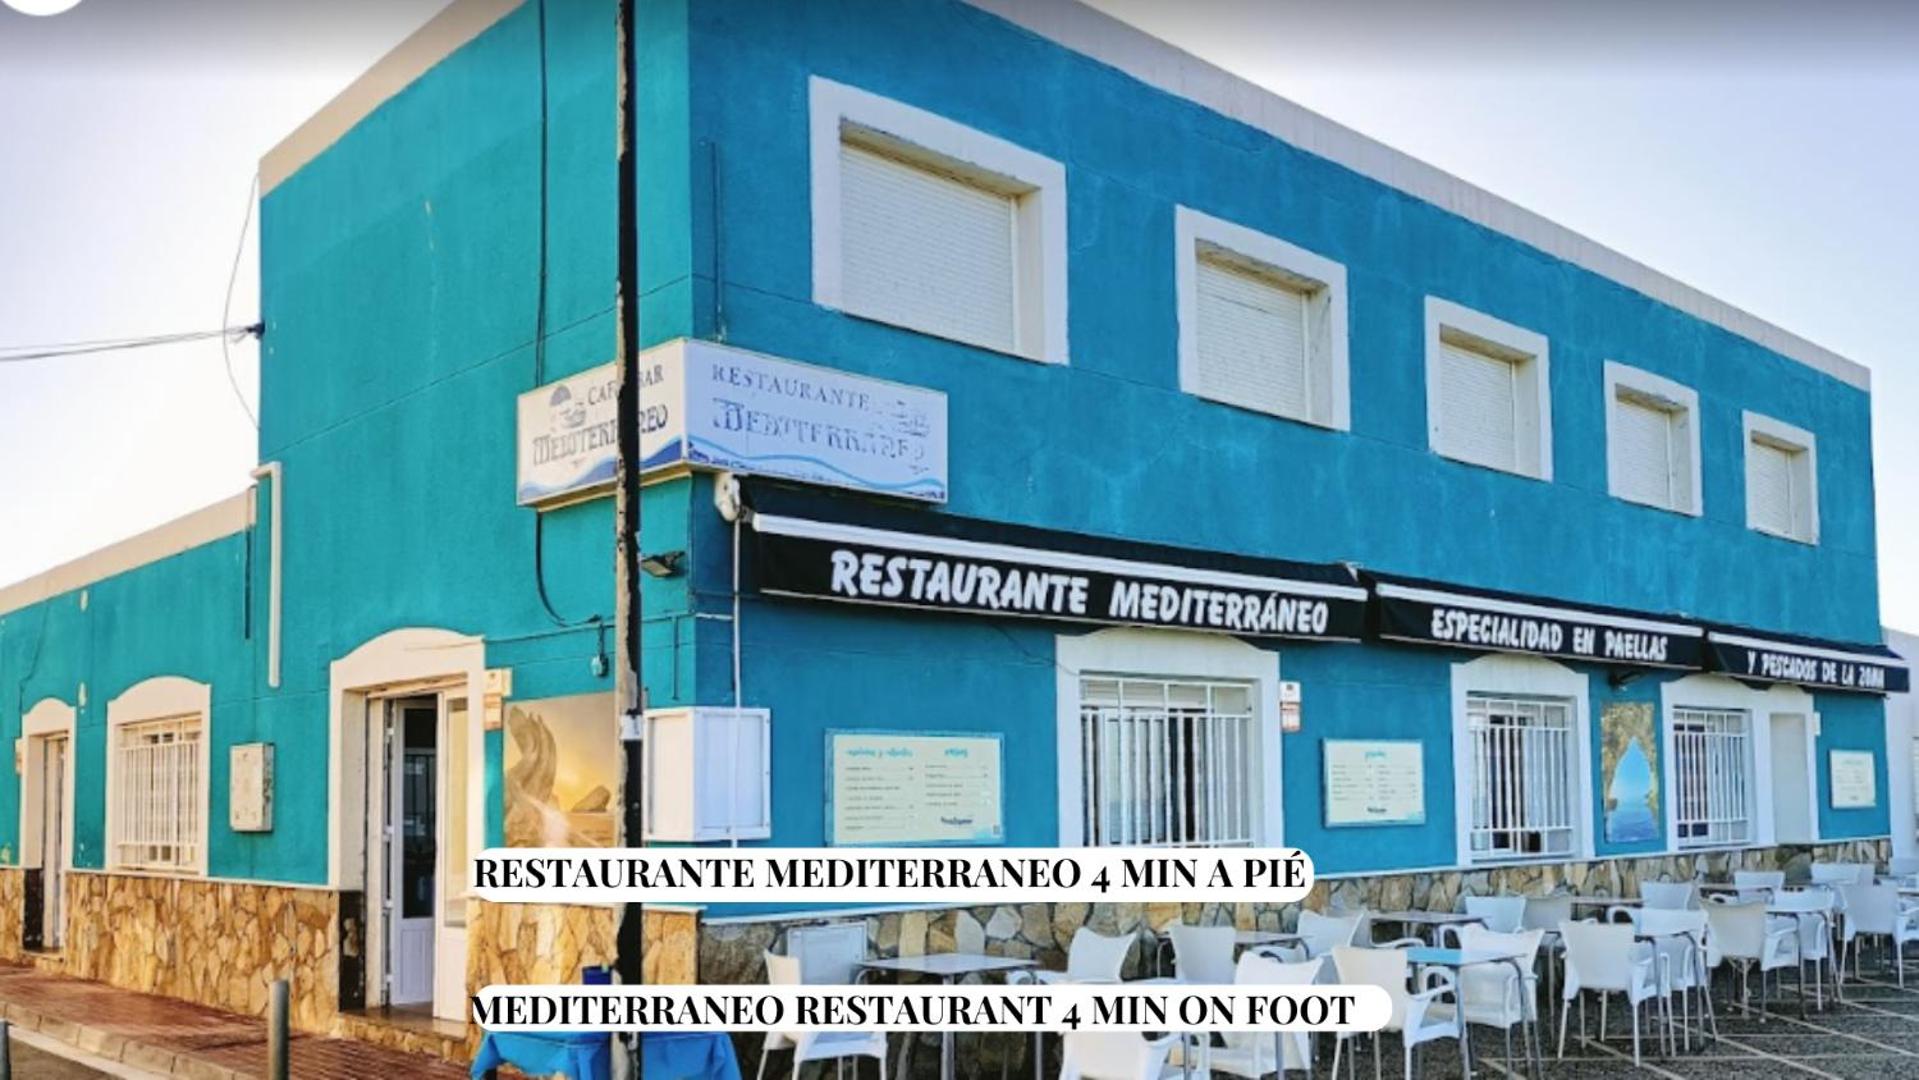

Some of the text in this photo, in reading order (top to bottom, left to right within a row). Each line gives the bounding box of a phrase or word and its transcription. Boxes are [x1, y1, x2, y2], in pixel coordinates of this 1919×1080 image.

[712, 363, 869, 412] RESTAURANTE
[830, 549, 1329, 635] RESTAURANTE MEDITERRÁNEO
[1431, 608, 1669, 662] ESPECIALIDAD EN PAELLAS
[1747, 650, 1757, 675] Y
[1761, 652, 1818, 682] PESCADOS
[1822, 661, 1838, 684] DE
[1842, 663, 1855, 687] LA
